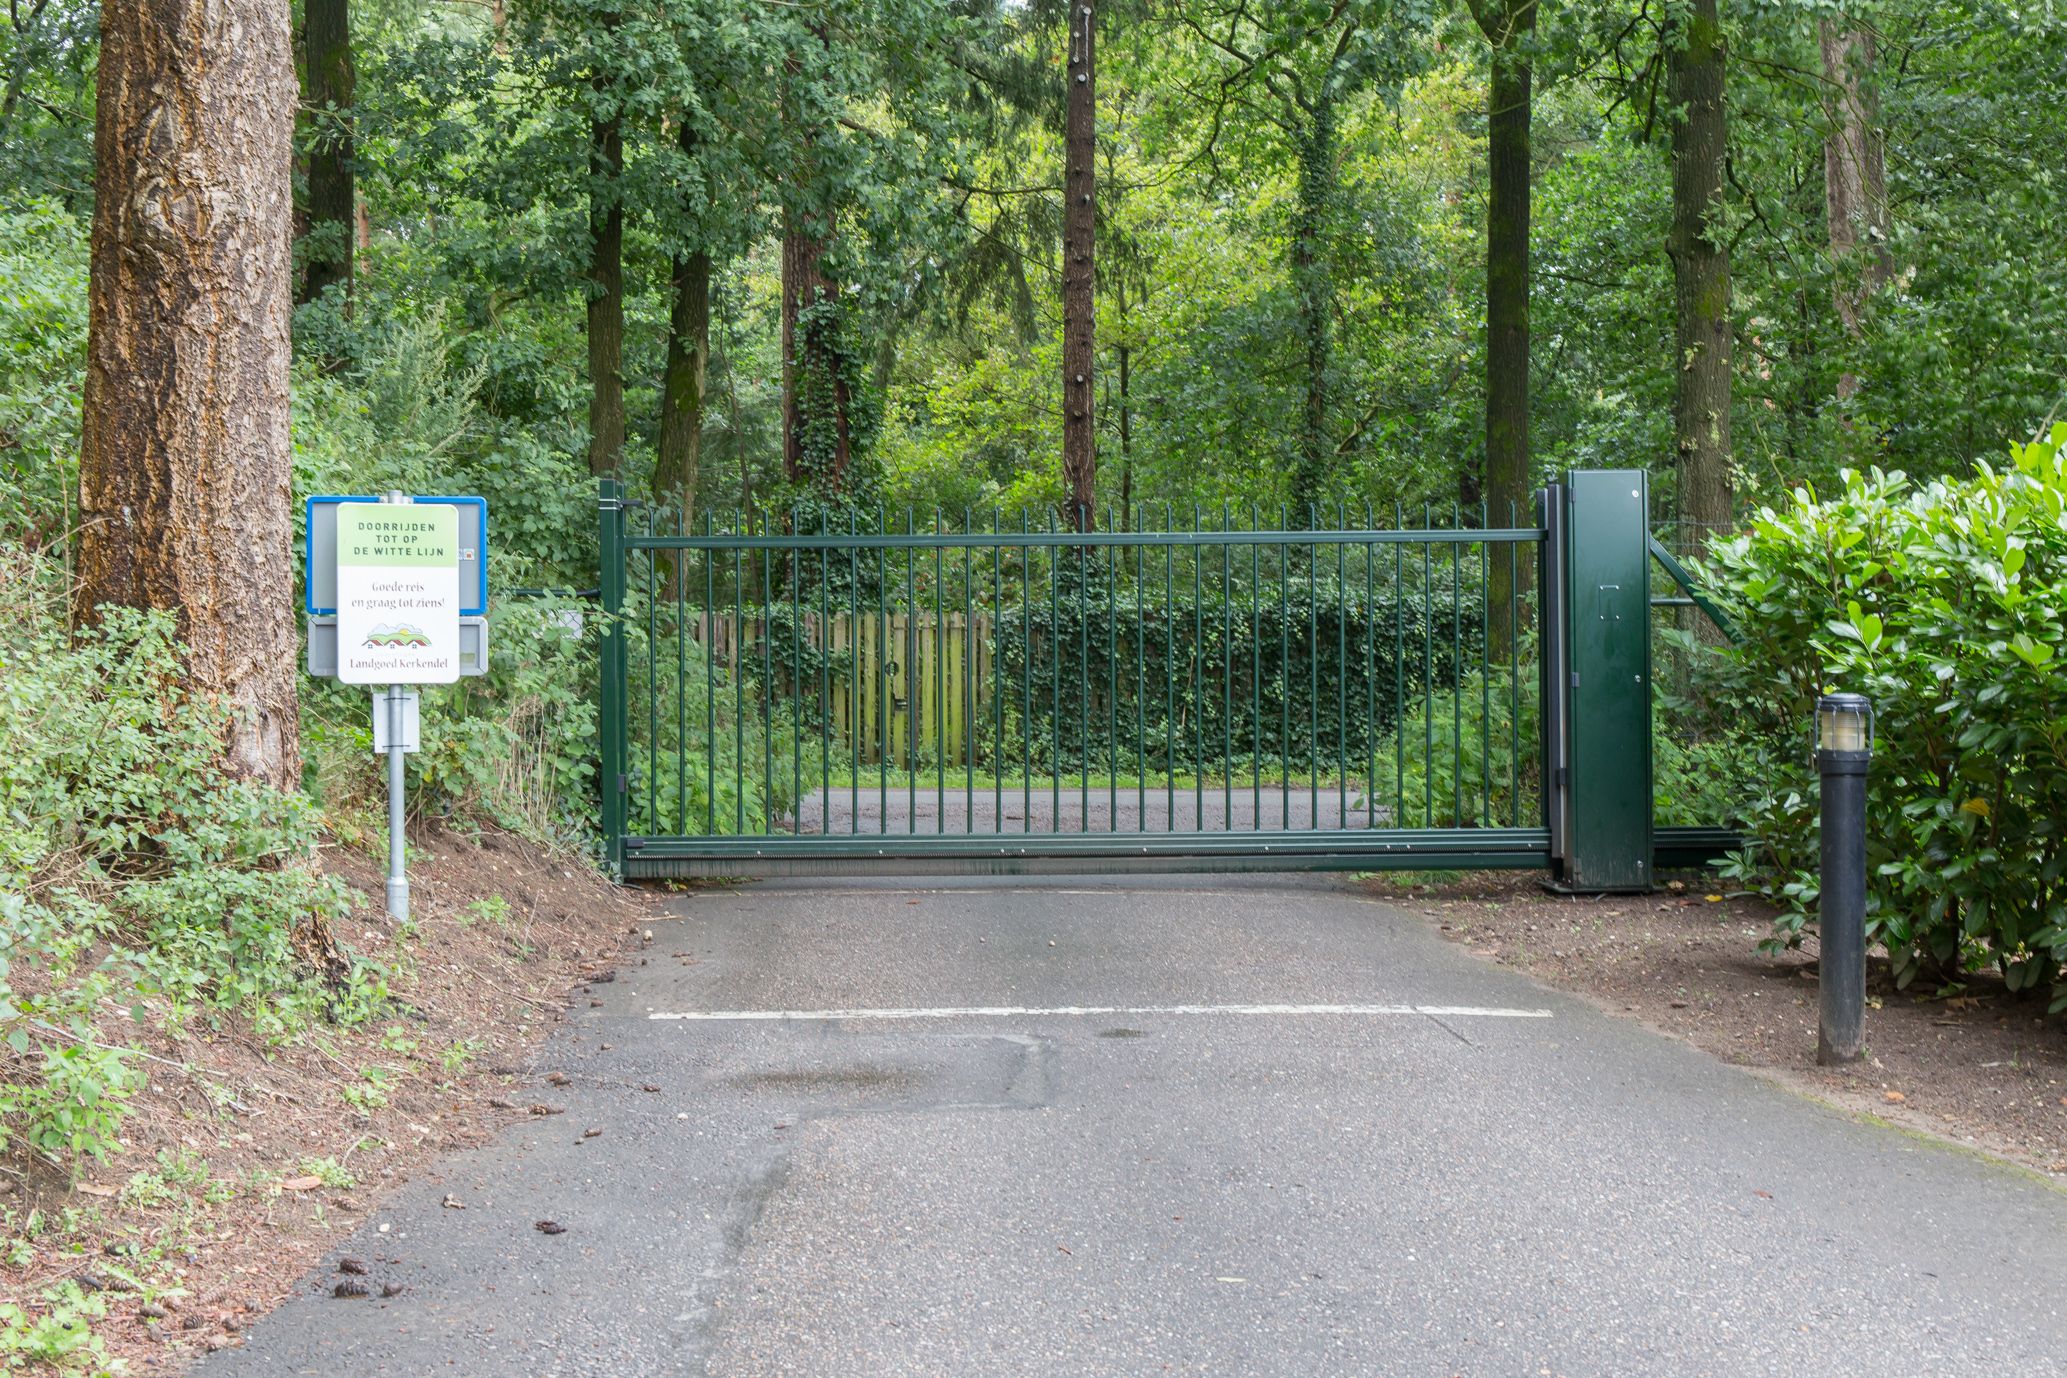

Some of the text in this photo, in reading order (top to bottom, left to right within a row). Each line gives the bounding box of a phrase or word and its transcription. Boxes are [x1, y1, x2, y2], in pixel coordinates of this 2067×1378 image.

[358, 522, 435, 532] DOORRIJDEN
[376, 535, 418, 544] TOT OP
[354, 546, 444, 556] DE WITTE LIJN
[372, 581, 424, 592] Goede reis
[351, 597, 445, 610] en graag tot ziens!
[350, 658, 448, 671] Landgoed Kerkendel
